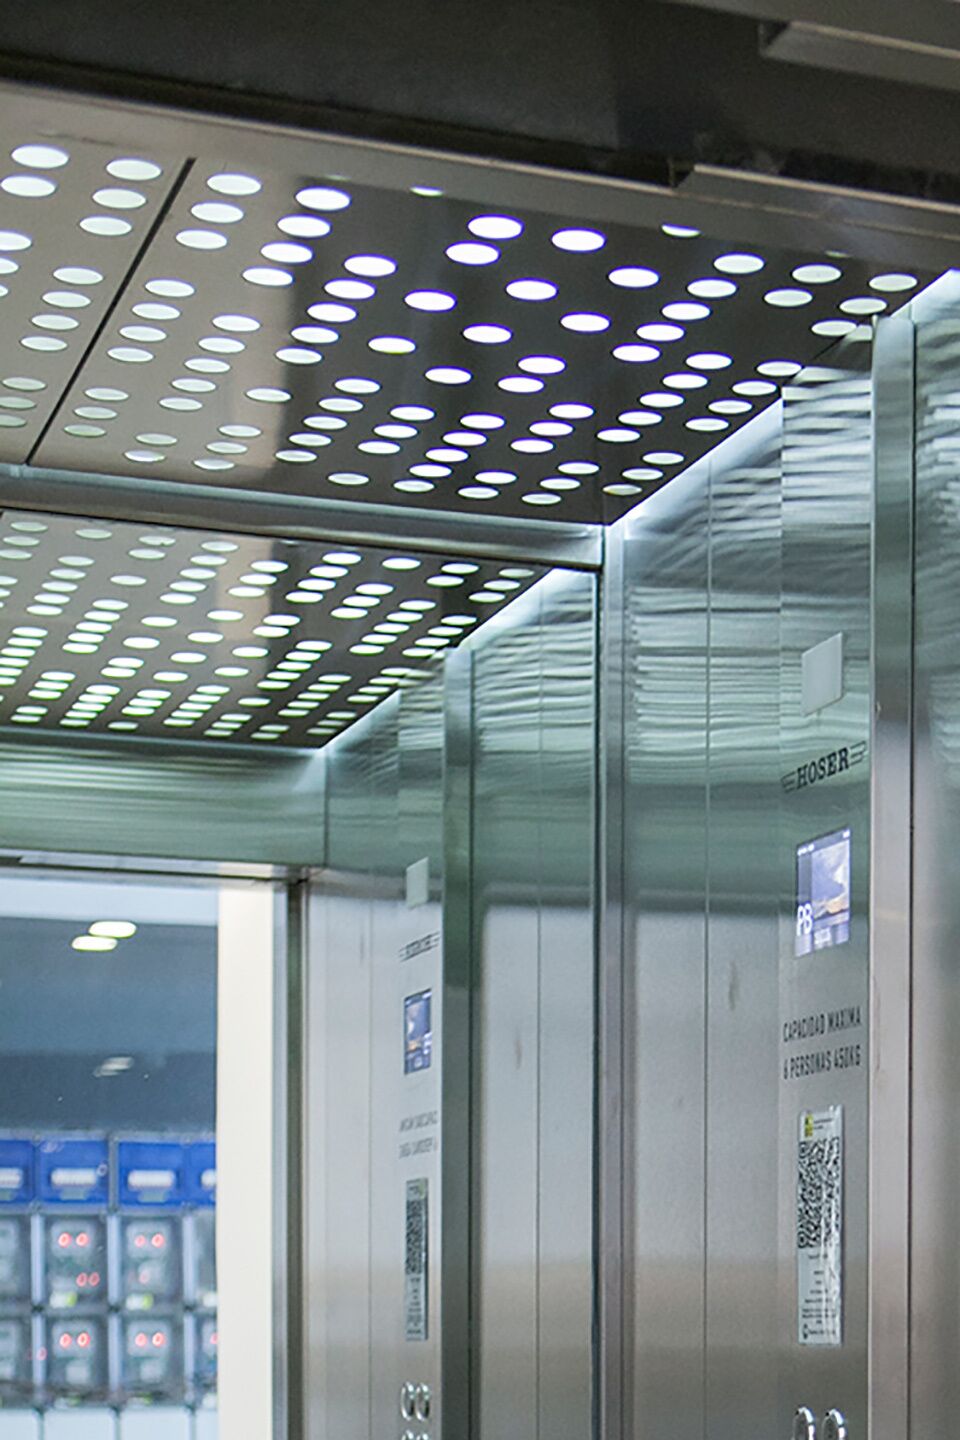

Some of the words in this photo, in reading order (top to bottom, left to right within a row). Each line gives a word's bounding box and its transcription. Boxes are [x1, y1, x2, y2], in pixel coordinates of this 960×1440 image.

[796, 747, 849, 790] HOSER
[796, 902, 813, 937] PB
[783, 1013, 825, 1042] CAPACIDAD
[790, 1050, 832, 1079] PERSONAS
